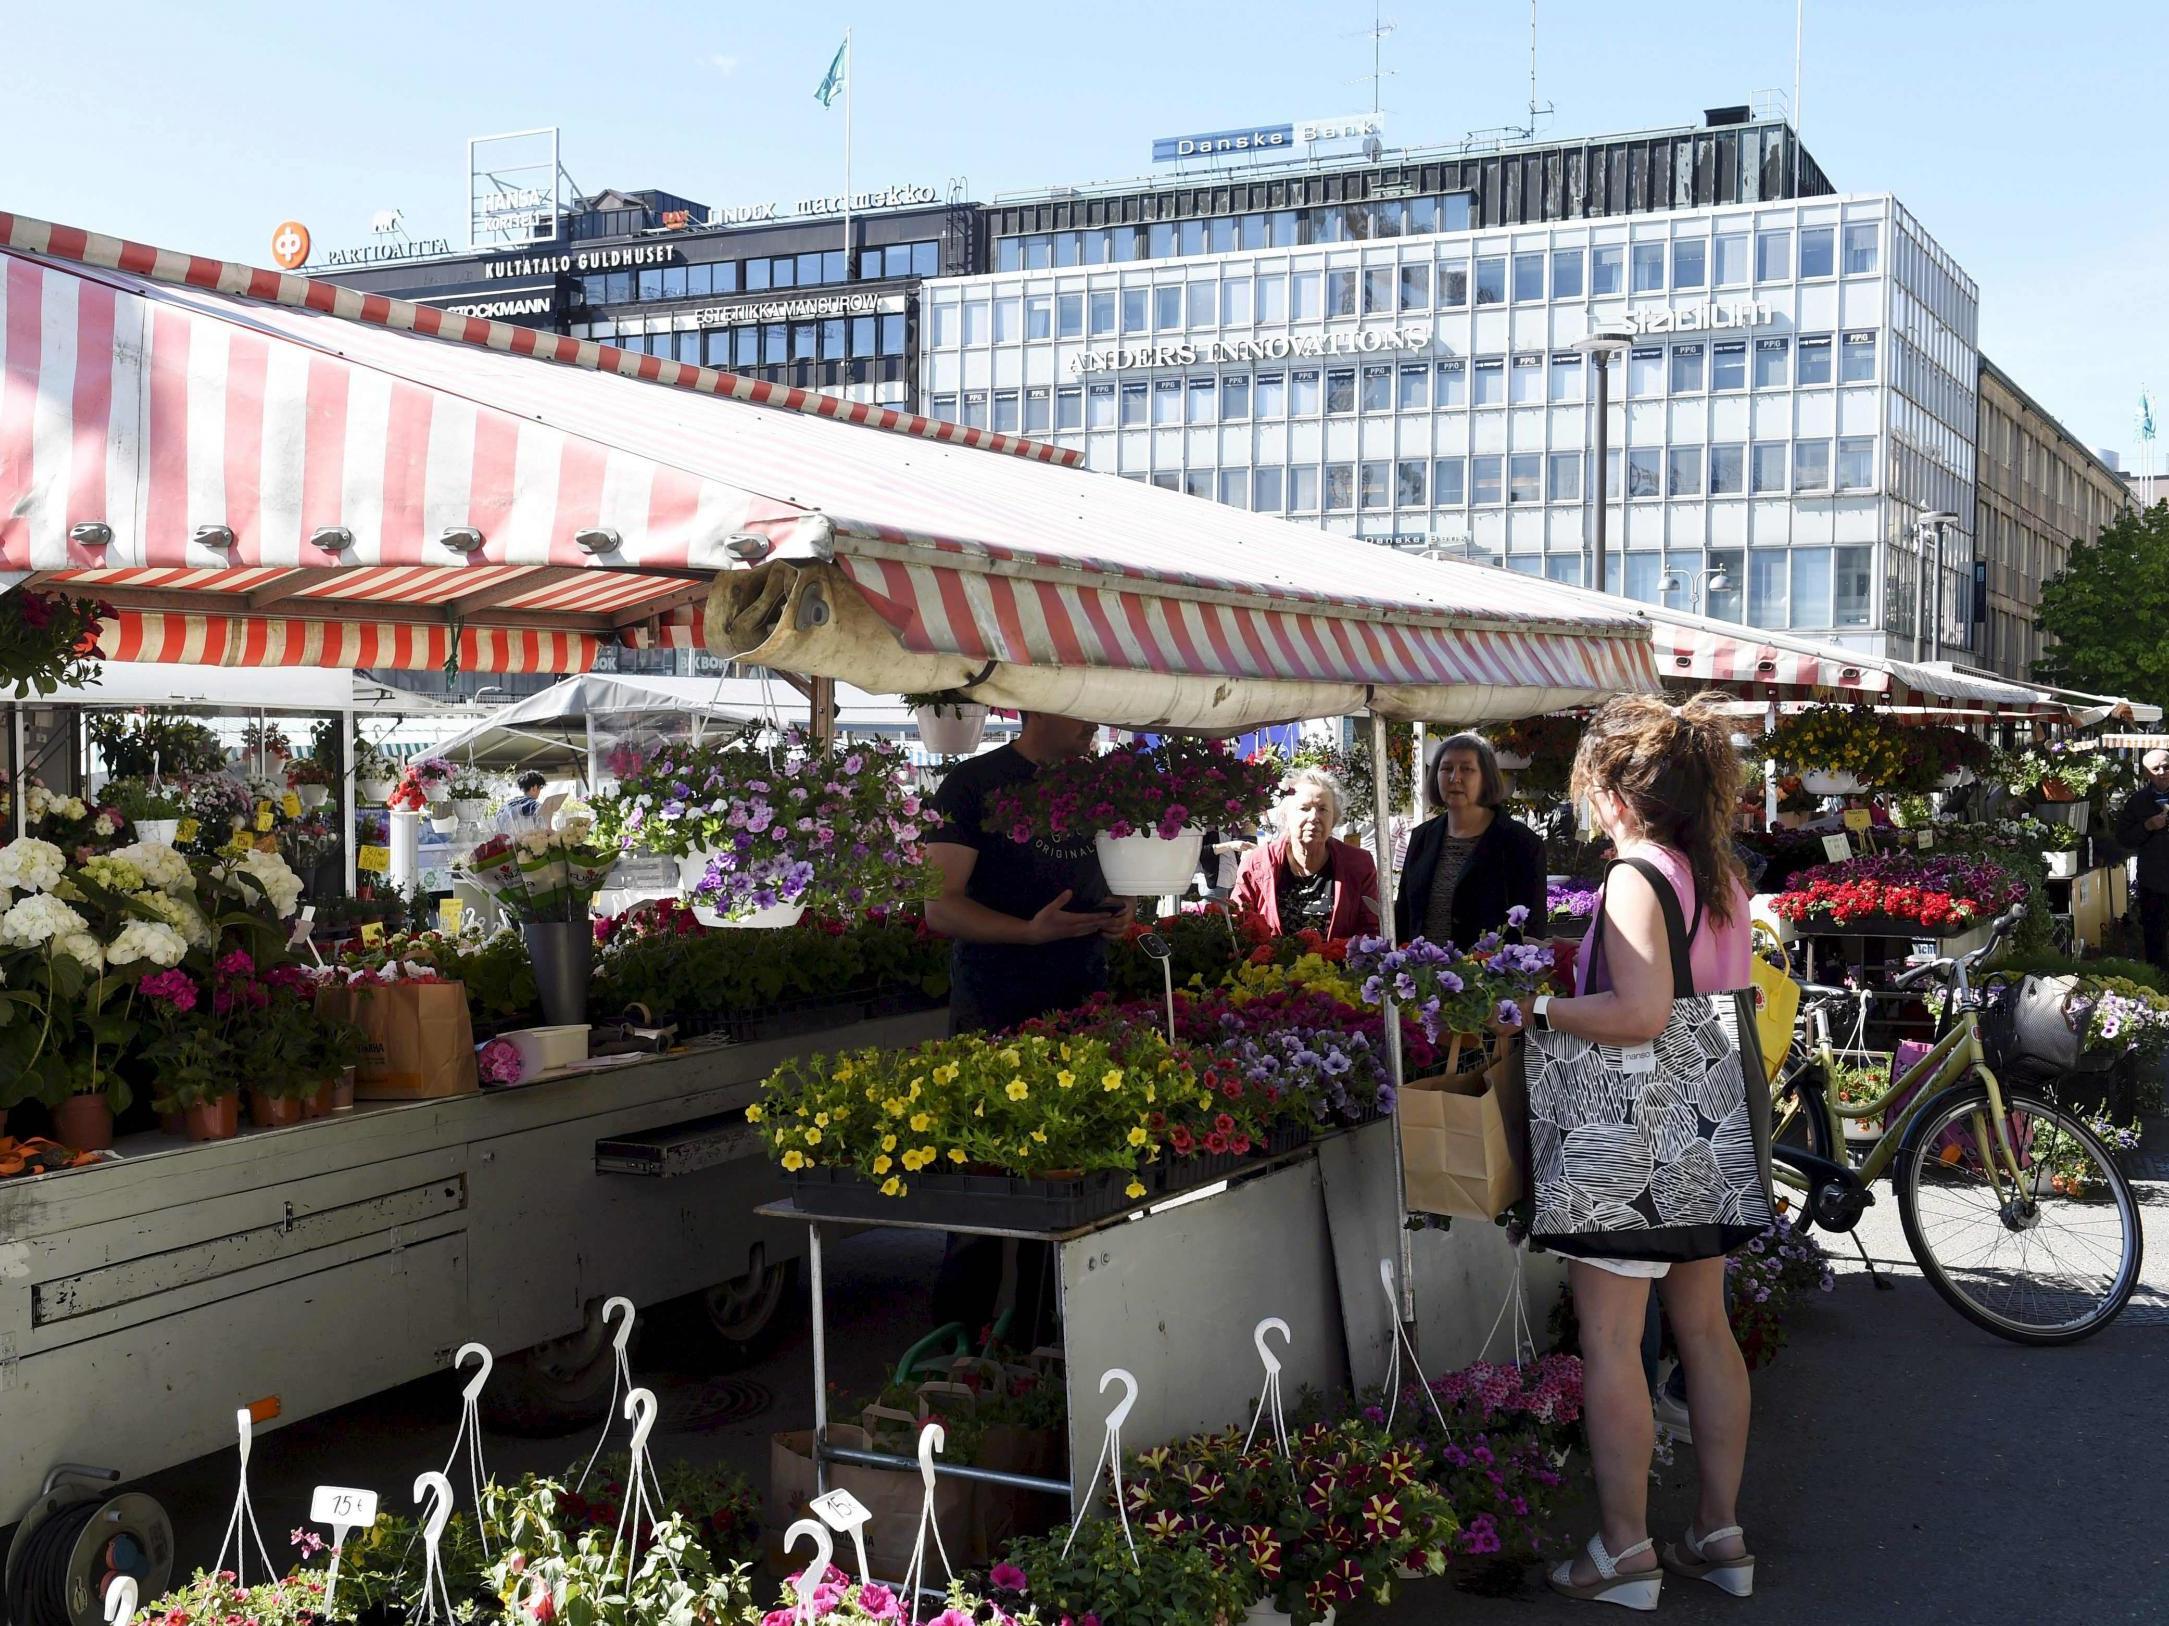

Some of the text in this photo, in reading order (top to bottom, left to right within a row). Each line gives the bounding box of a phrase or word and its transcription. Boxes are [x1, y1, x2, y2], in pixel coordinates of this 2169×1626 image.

[1178, 120, 1375, 156] Danske Bank
[708, 202, 776, 225] LINDEX
[793, 184, 936, 215] marmekko
[328, 238, 451, 265] PARTIOAITTA
[485, 256, 571, 279] KULTATALO
[578, 244, 674, 269] GULDHUSET
[695, 293, 880, 325] ESTETIIKKA MANSUROW
[1068, 326, 1432, 373] ANDERS INNOVATIONS
